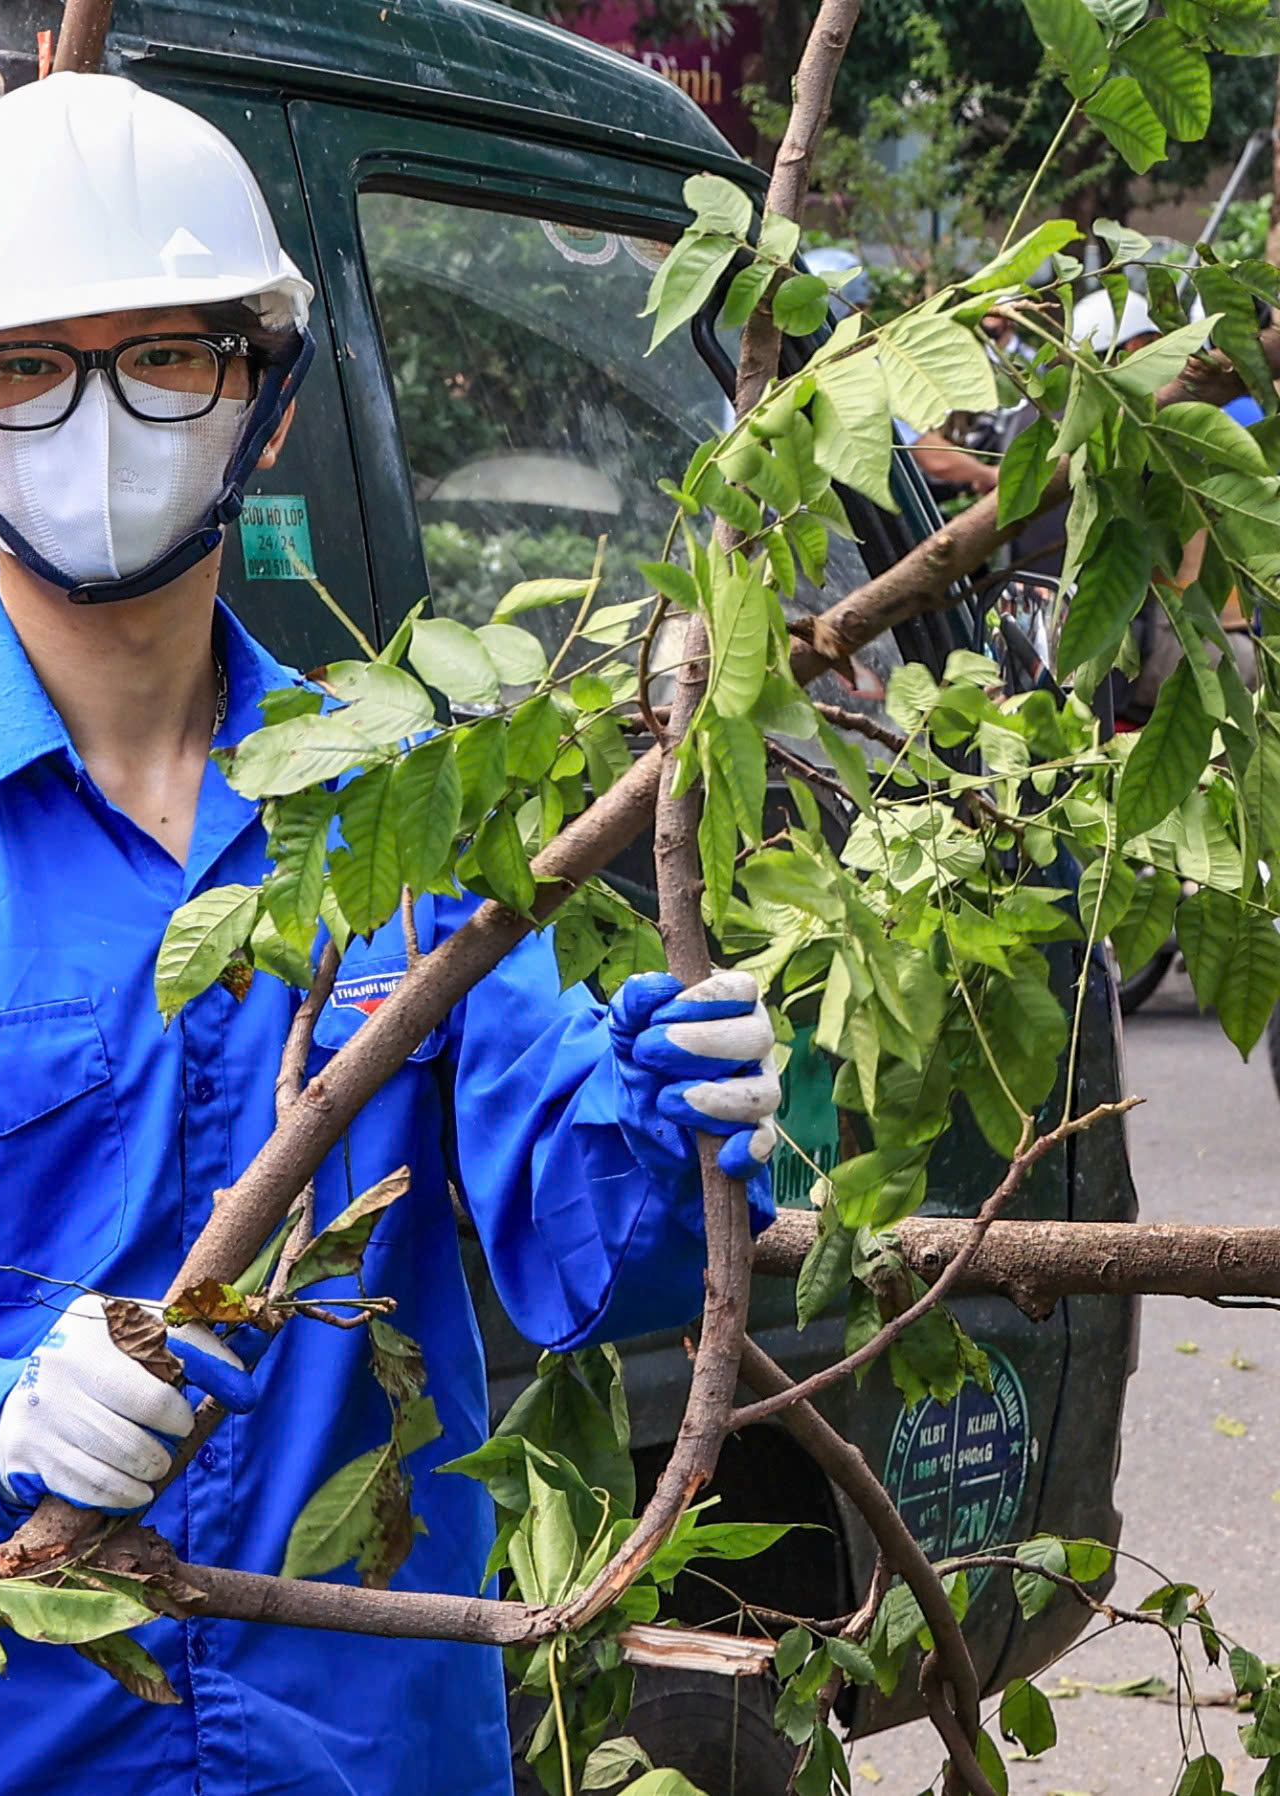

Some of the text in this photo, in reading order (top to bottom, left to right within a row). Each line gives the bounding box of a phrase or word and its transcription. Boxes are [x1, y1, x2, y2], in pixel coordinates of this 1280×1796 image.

[336, 982, 379, 999] THANH
[919, 1412, 999, 1448] KLBT KLHH
